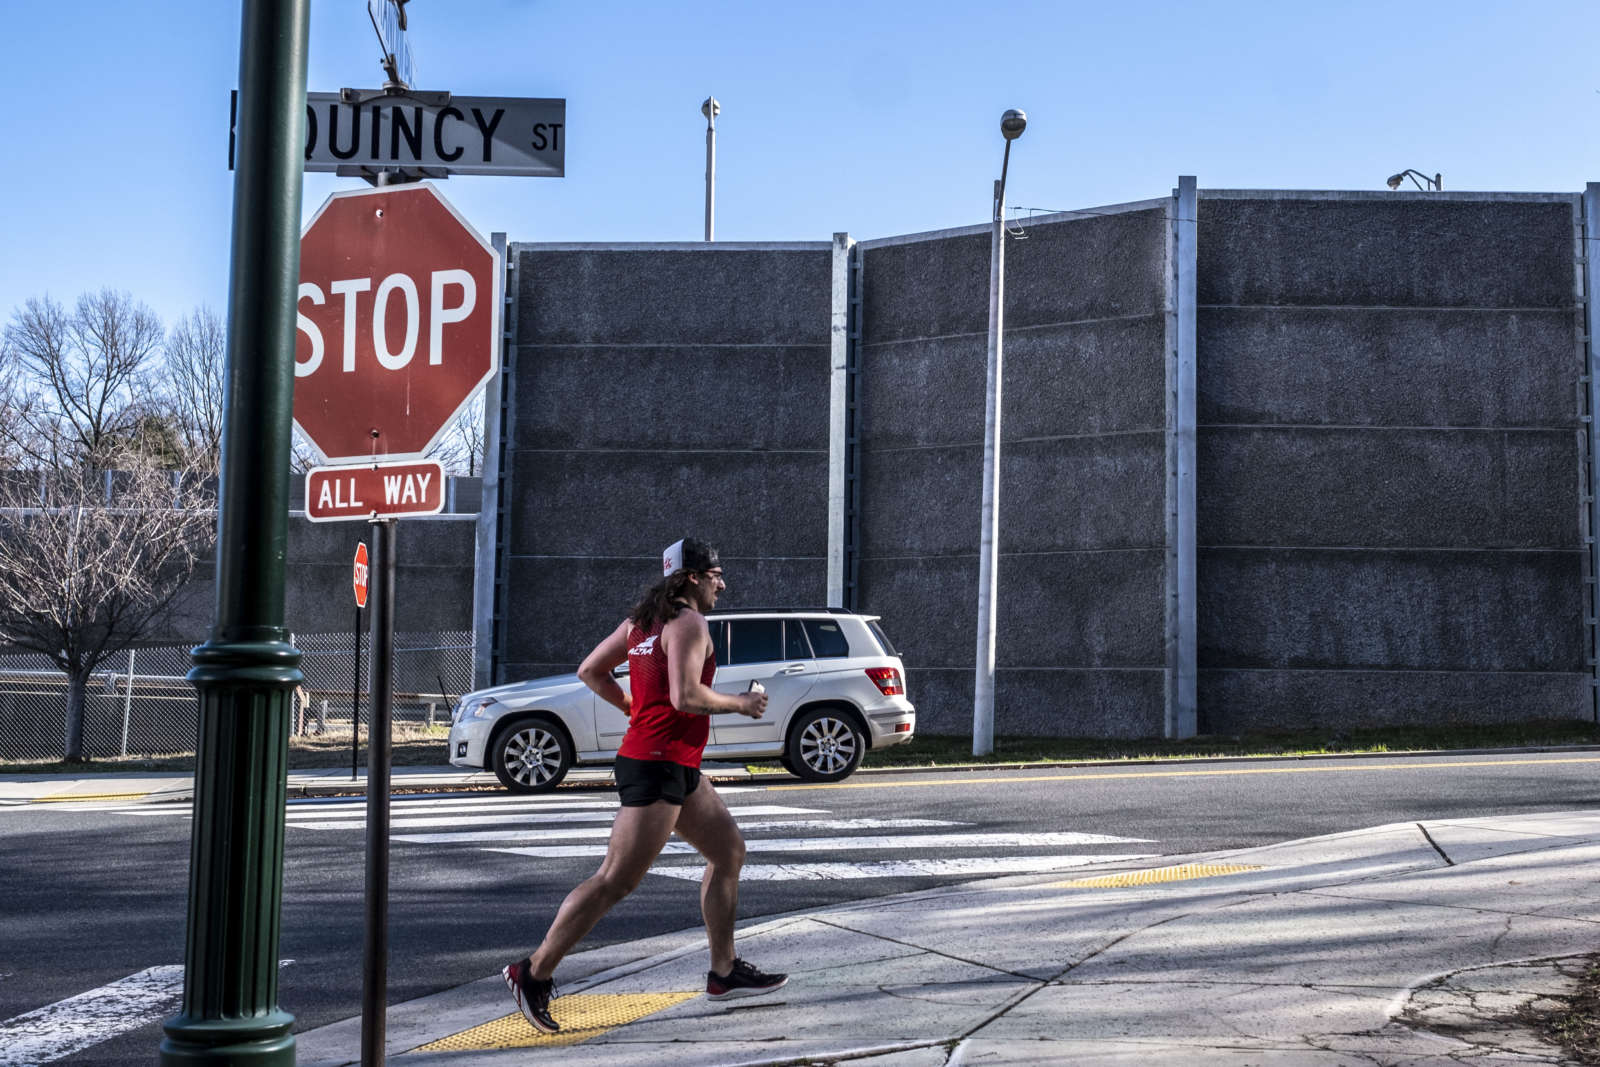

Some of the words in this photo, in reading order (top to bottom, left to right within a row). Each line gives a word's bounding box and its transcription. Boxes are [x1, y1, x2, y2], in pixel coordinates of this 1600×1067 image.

[531, 123, 563, 151] ST
[295, 268, 476, 377] STOP
[318, 478, 363, 509] ALL
[383, 472, 431, 504] WAY
[355, 562, 368, 587] STOP
